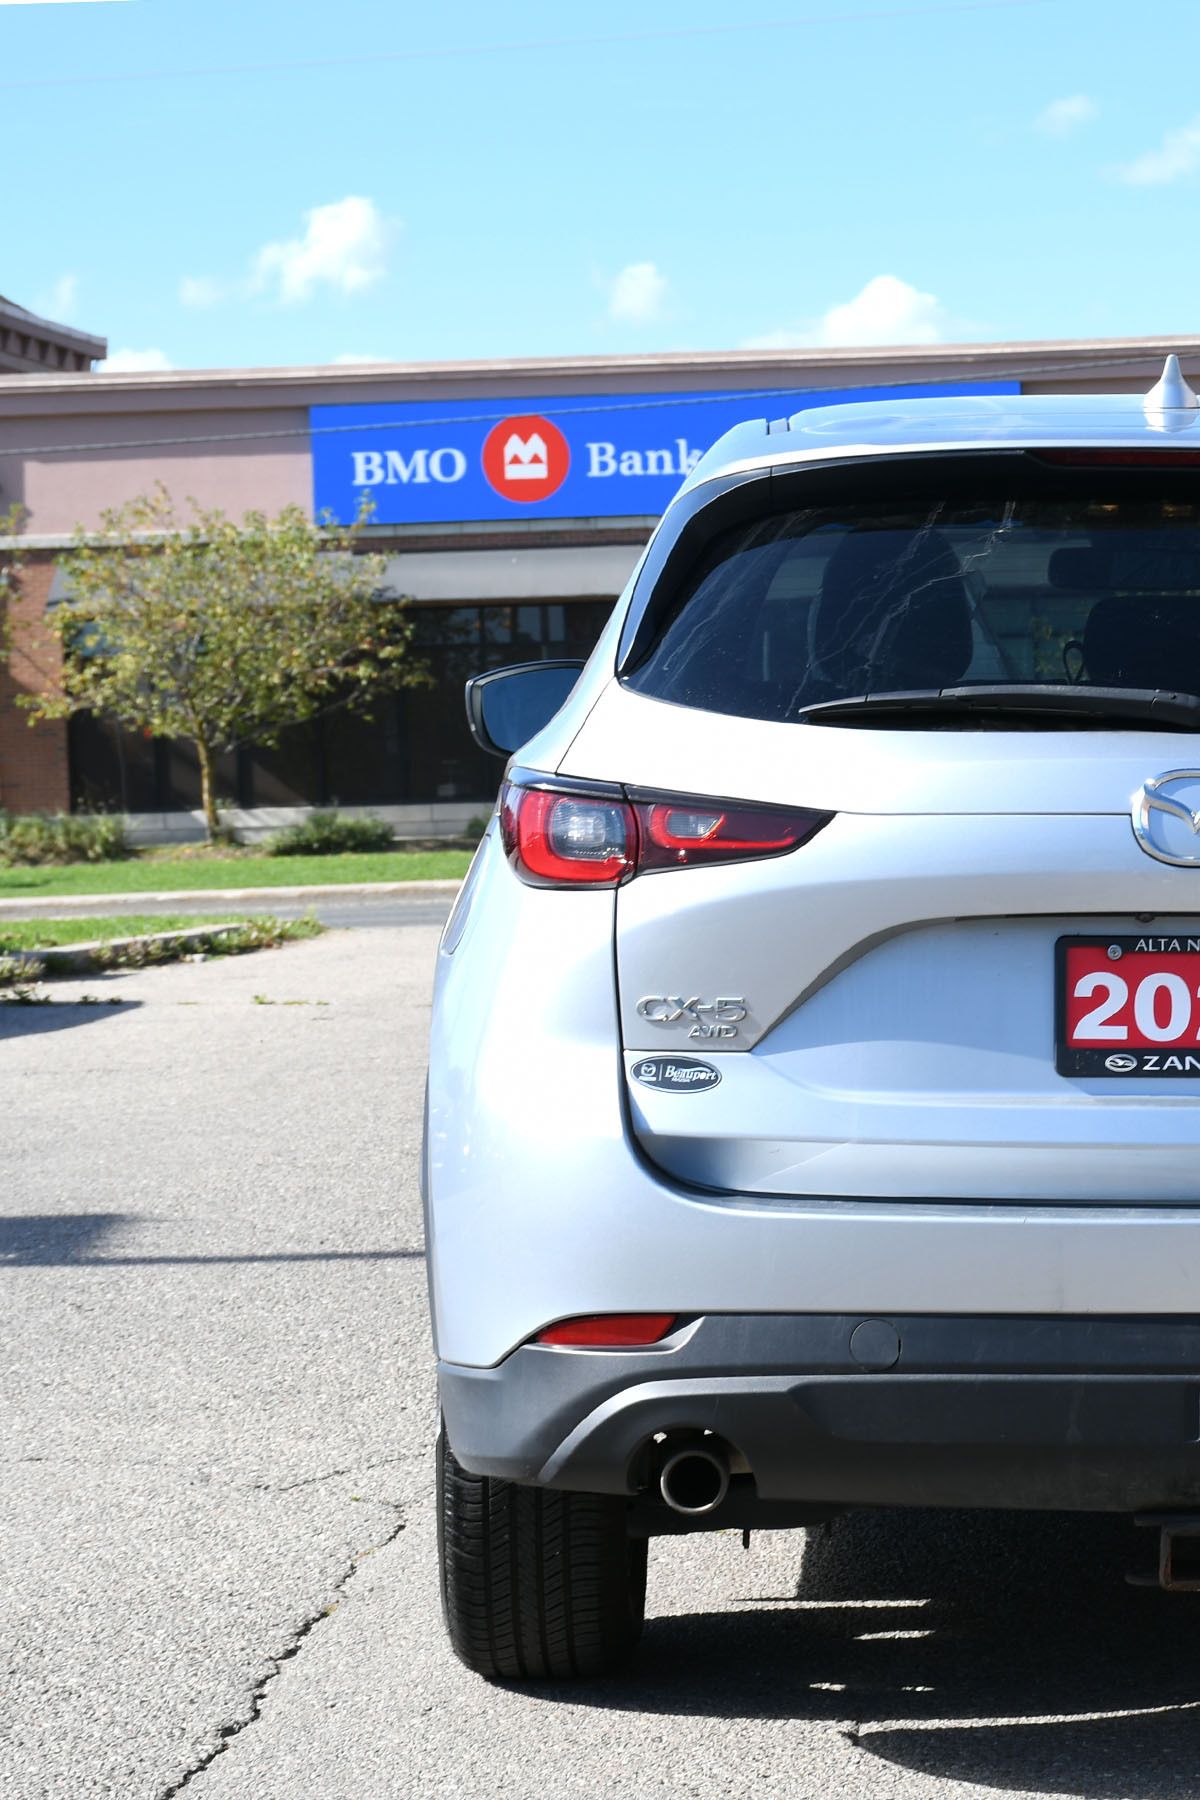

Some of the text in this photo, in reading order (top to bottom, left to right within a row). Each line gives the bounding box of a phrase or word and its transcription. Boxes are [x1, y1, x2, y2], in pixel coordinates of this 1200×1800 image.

[351, 438, 704, 487] BMO Bank
[1135, 938, 1181, 953] ALTA
[636, 994, 748, 1023] CX-5
[687, 1024, 738, 1039] AWD
